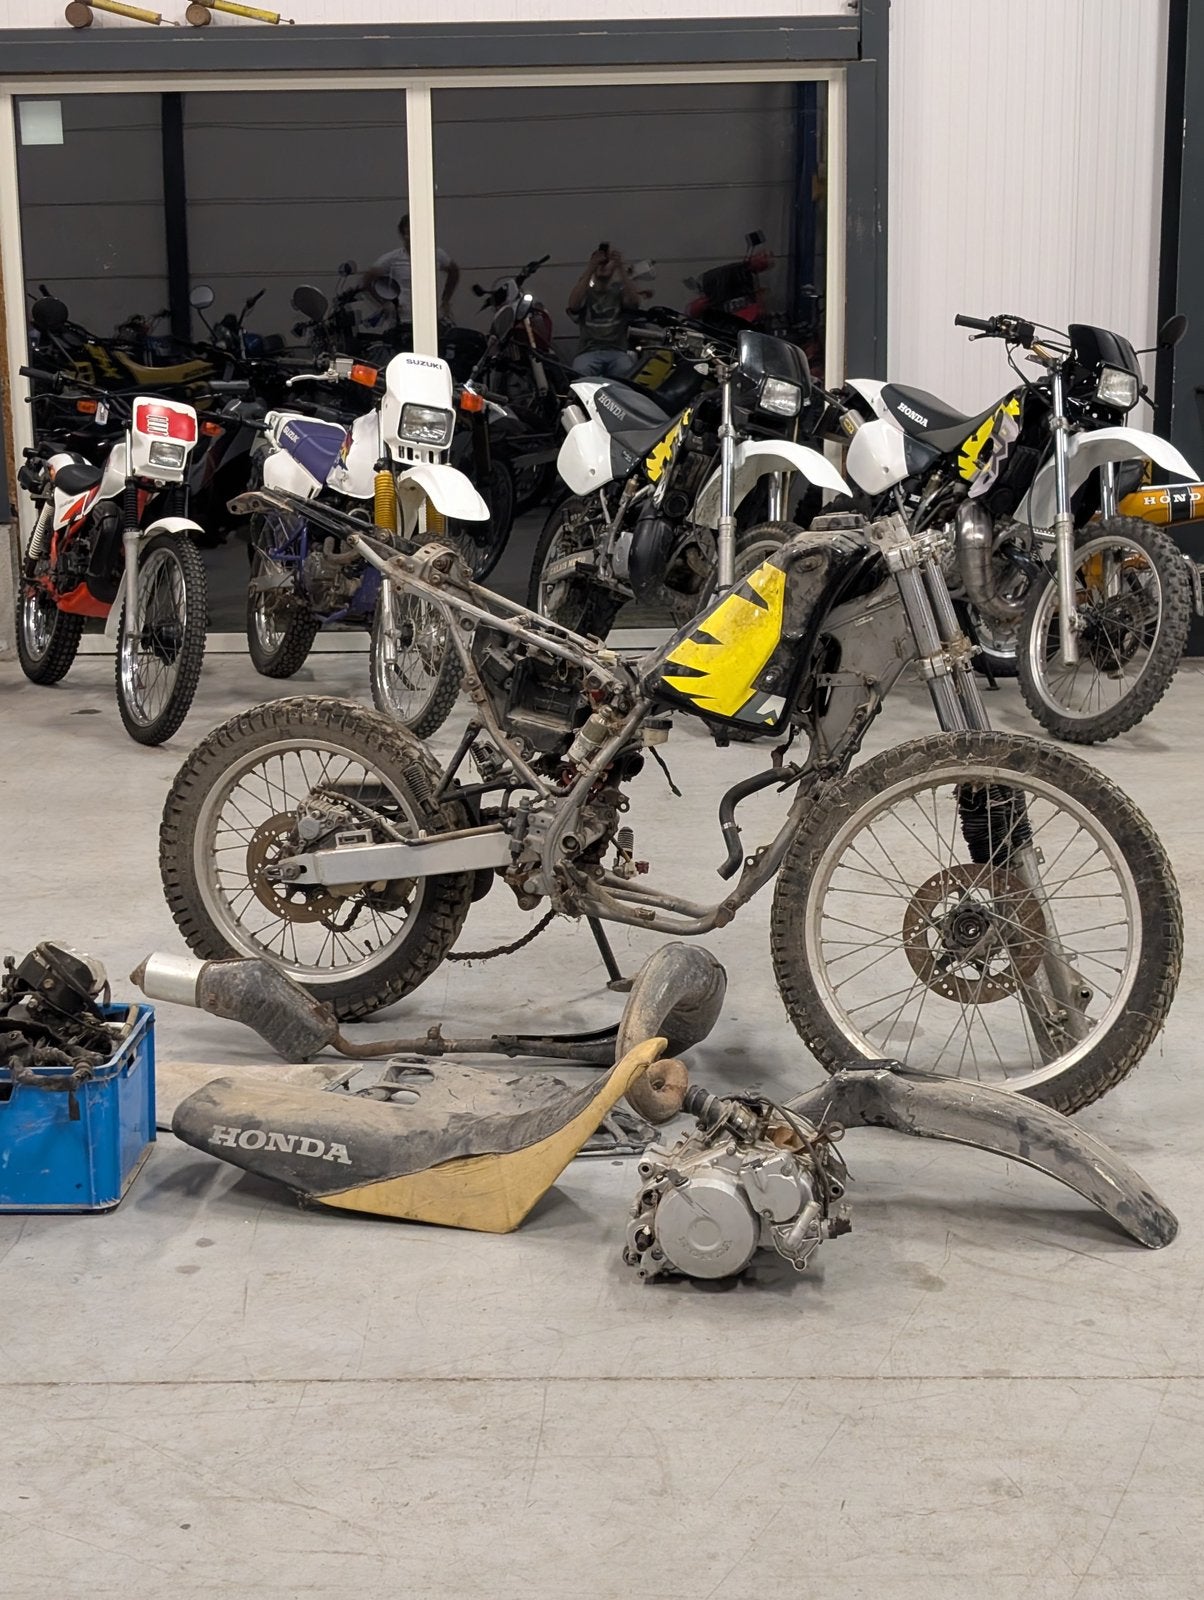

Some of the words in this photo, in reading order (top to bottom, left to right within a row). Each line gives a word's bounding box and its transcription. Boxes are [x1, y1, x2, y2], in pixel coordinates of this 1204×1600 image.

[406, 359, 442, 370] SUZUKI
[598, 393, 626, 421] HONDA
[897, 402, 929, 428] HONDA
[1143, 492, 1201, 505] HOND
[208, 1124, 353, 1165] HONDA
